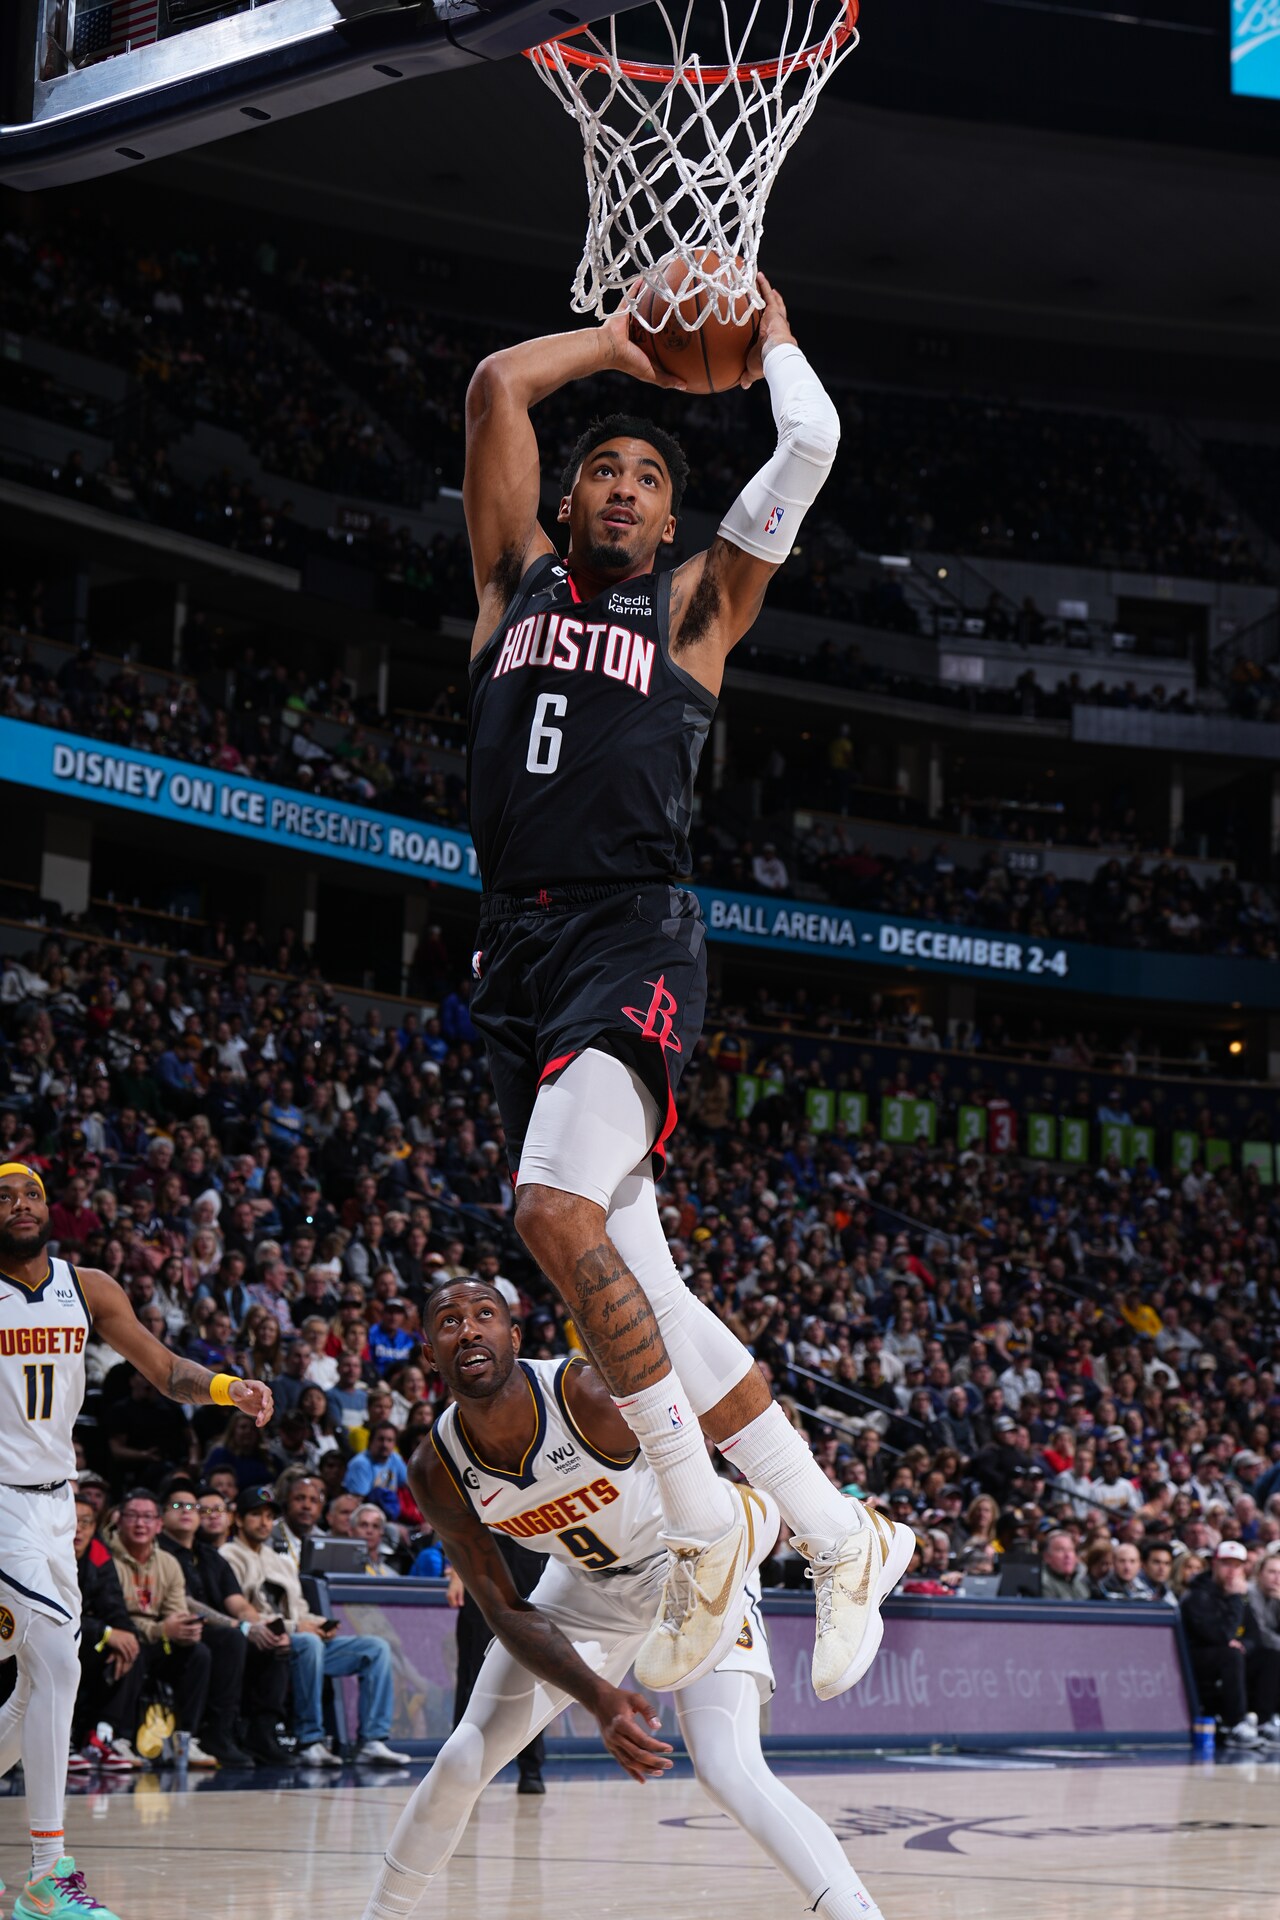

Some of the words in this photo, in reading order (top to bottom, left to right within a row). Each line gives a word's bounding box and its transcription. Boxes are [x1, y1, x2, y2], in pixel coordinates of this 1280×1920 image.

[551, 565, 567, 577] 6
[608, 599, 652, 616] karma
[493, 612, 656, 697] HOUSTON
[525, 692, 568, 775] 6
[53, 745, 163, 798] DISNEY
[170, 775, 213, 812] ON
[220, 786, 265, 824] ICE
[271, 798, 383, 852] PRESENTS
[388, 827, 462, 871] ROAD
[466, 846, 482, 878] T
[711, 900, 767, 935] BALL
[772, 909, 856, 947] ARENA
[879, 925, 1022, 971] DECEMBER
[1027, 946, 1069, 978] 2-4
[813, 1094, 829, 1130] 3
[846, 1097, 861, 1133] 3
[888, 1101, 903, 1137] 3
[914, 1104, 930, 1137] 3
[965, 1111, 981, 1147] 3
[996, 1115, 1010, 1149] 3
[1035, 1119, 1049, 1152] 3
[1068, 1122, 1083, 1157] 3
[1179, 1136, 1193, 1170] 3
[54, 1288, 73, 1299] WU
[23, 1363, 54, 1421] 11
[546, 1442, 575, 1464] WU
[554, 1456, 581, 1471] Western
[562, 1463, 581, 1474] Union
[556, 1524, 620, 1572] 9
[938, 1667, 998, 1698] care
[1005, 1658, 1043, 1698] for
[1051, 1668, 1108, 1705] your
